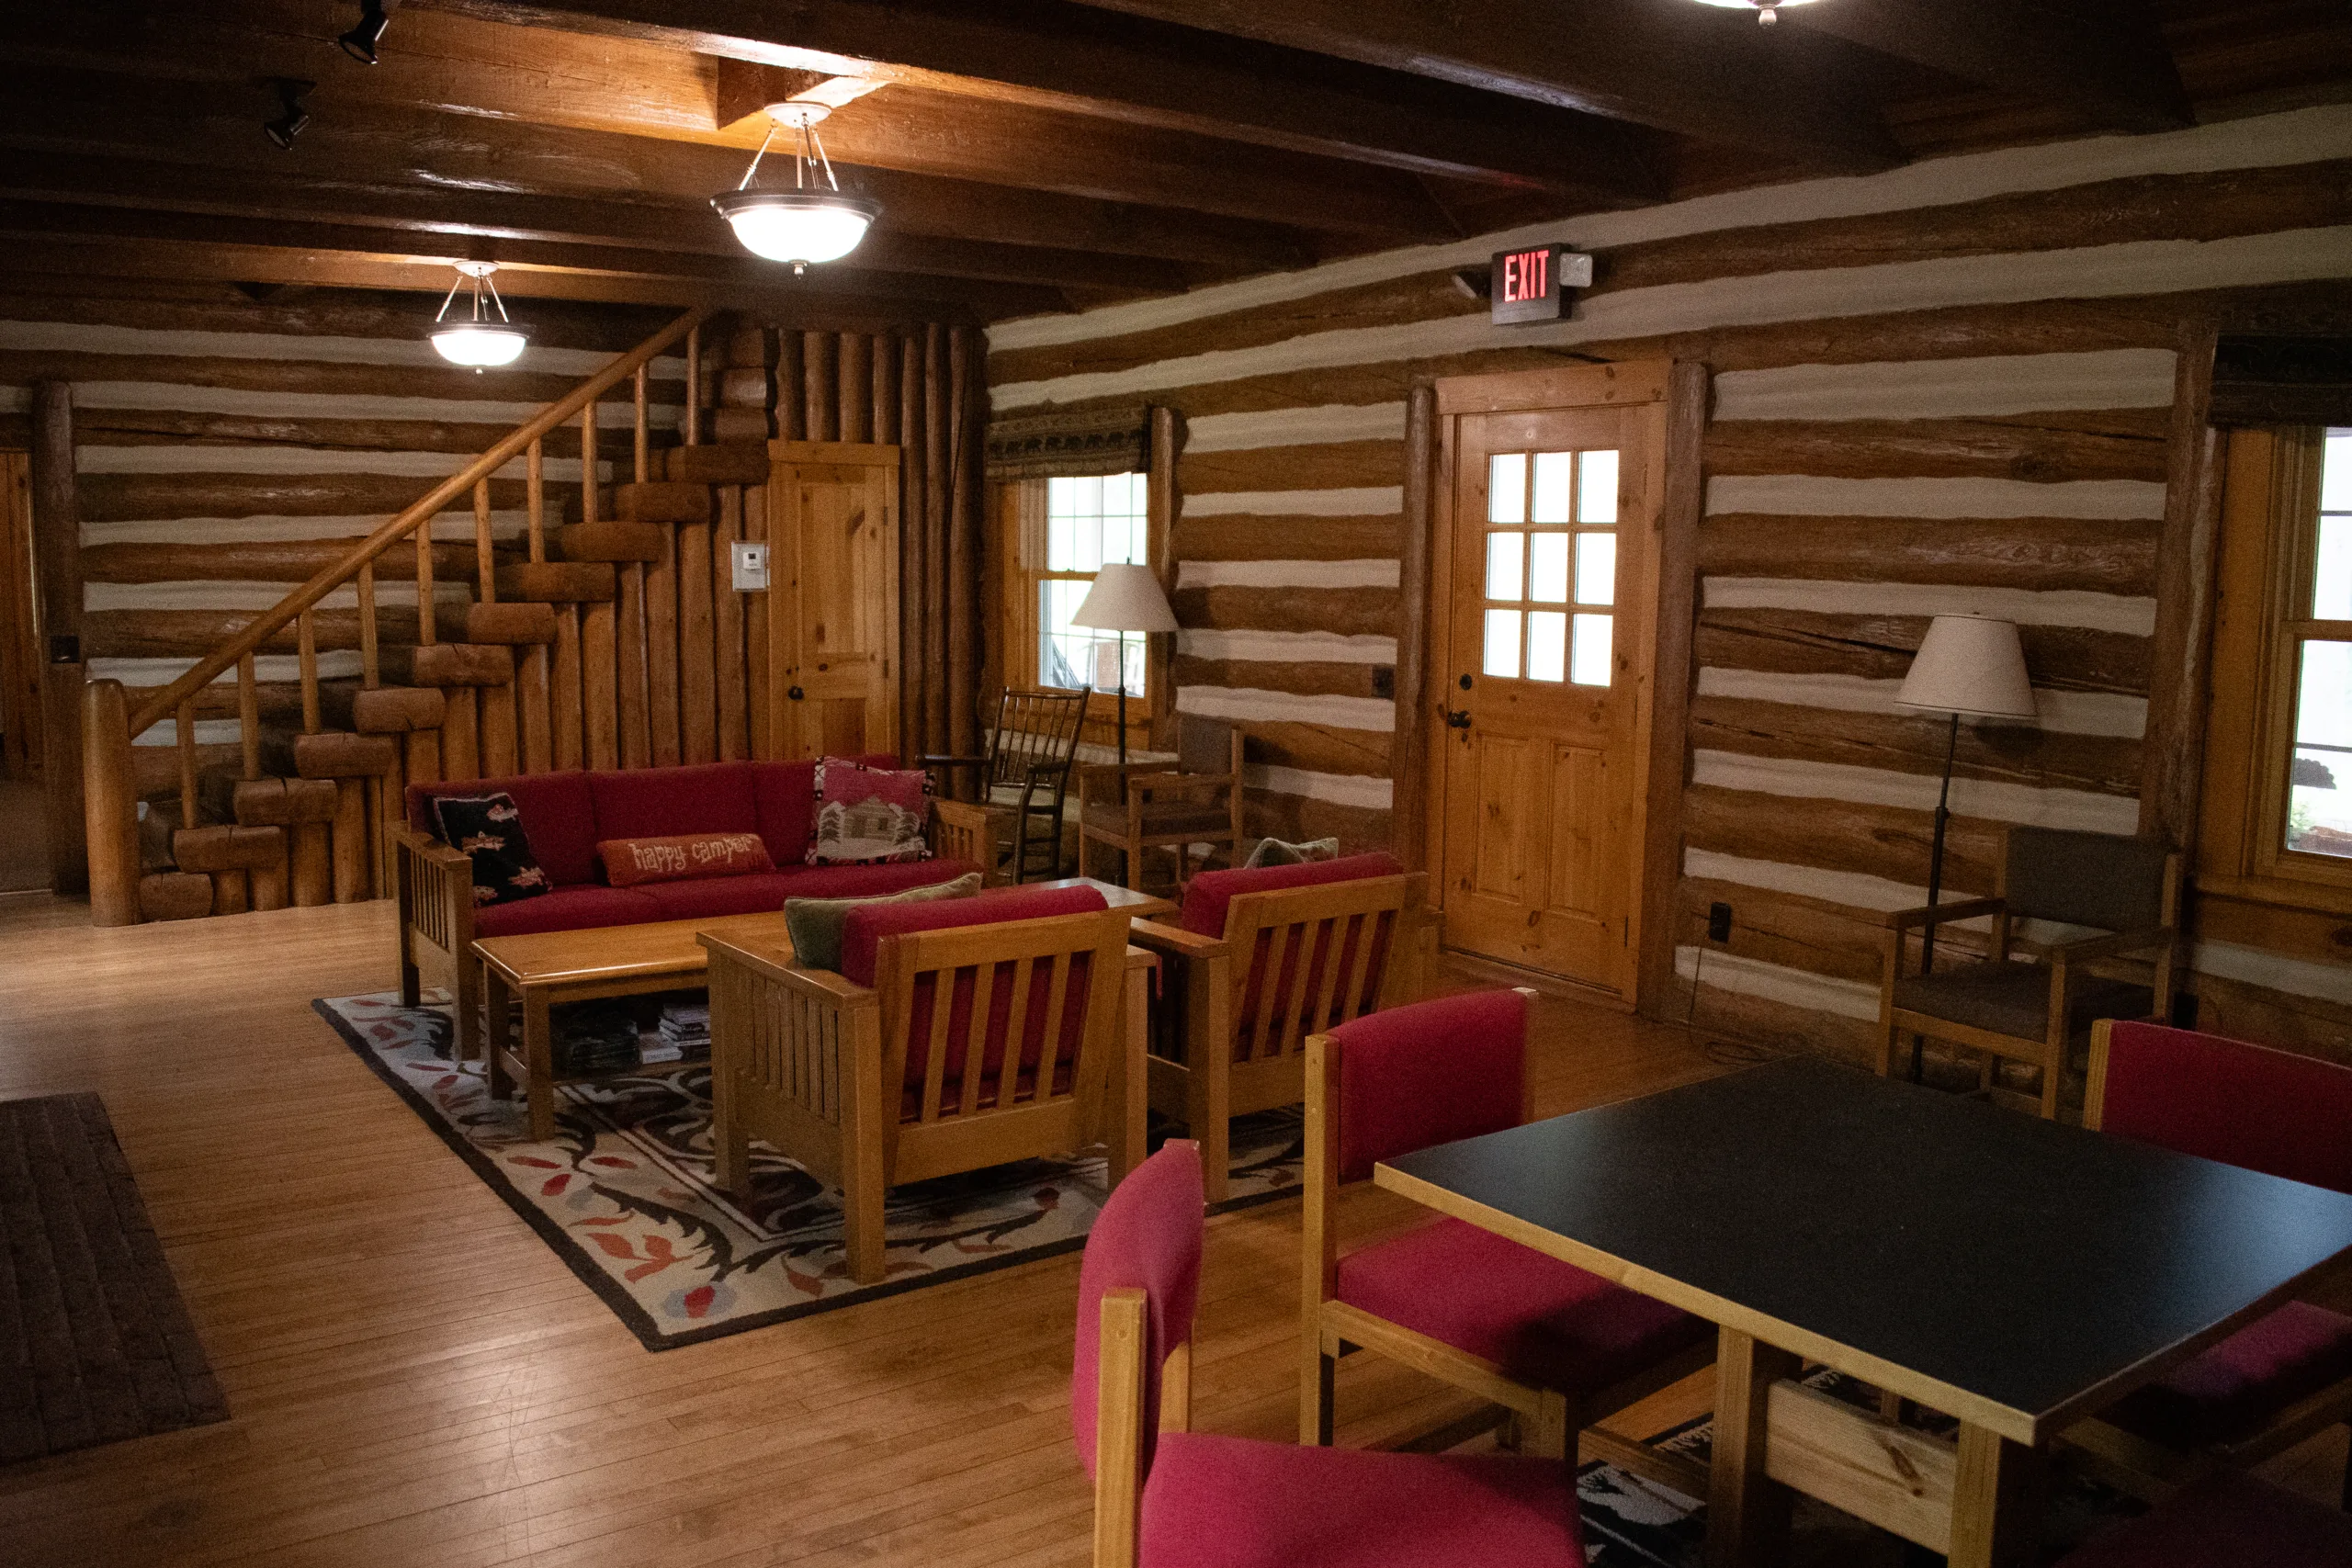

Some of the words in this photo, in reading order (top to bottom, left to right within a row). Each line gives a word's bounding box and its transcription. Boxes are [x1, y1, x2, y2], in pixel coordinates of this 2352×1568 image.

[1504, 249, 1549, 302] EXIT
[628, 842, 686, 872] happy
[691, 835, 753, 863] camper
